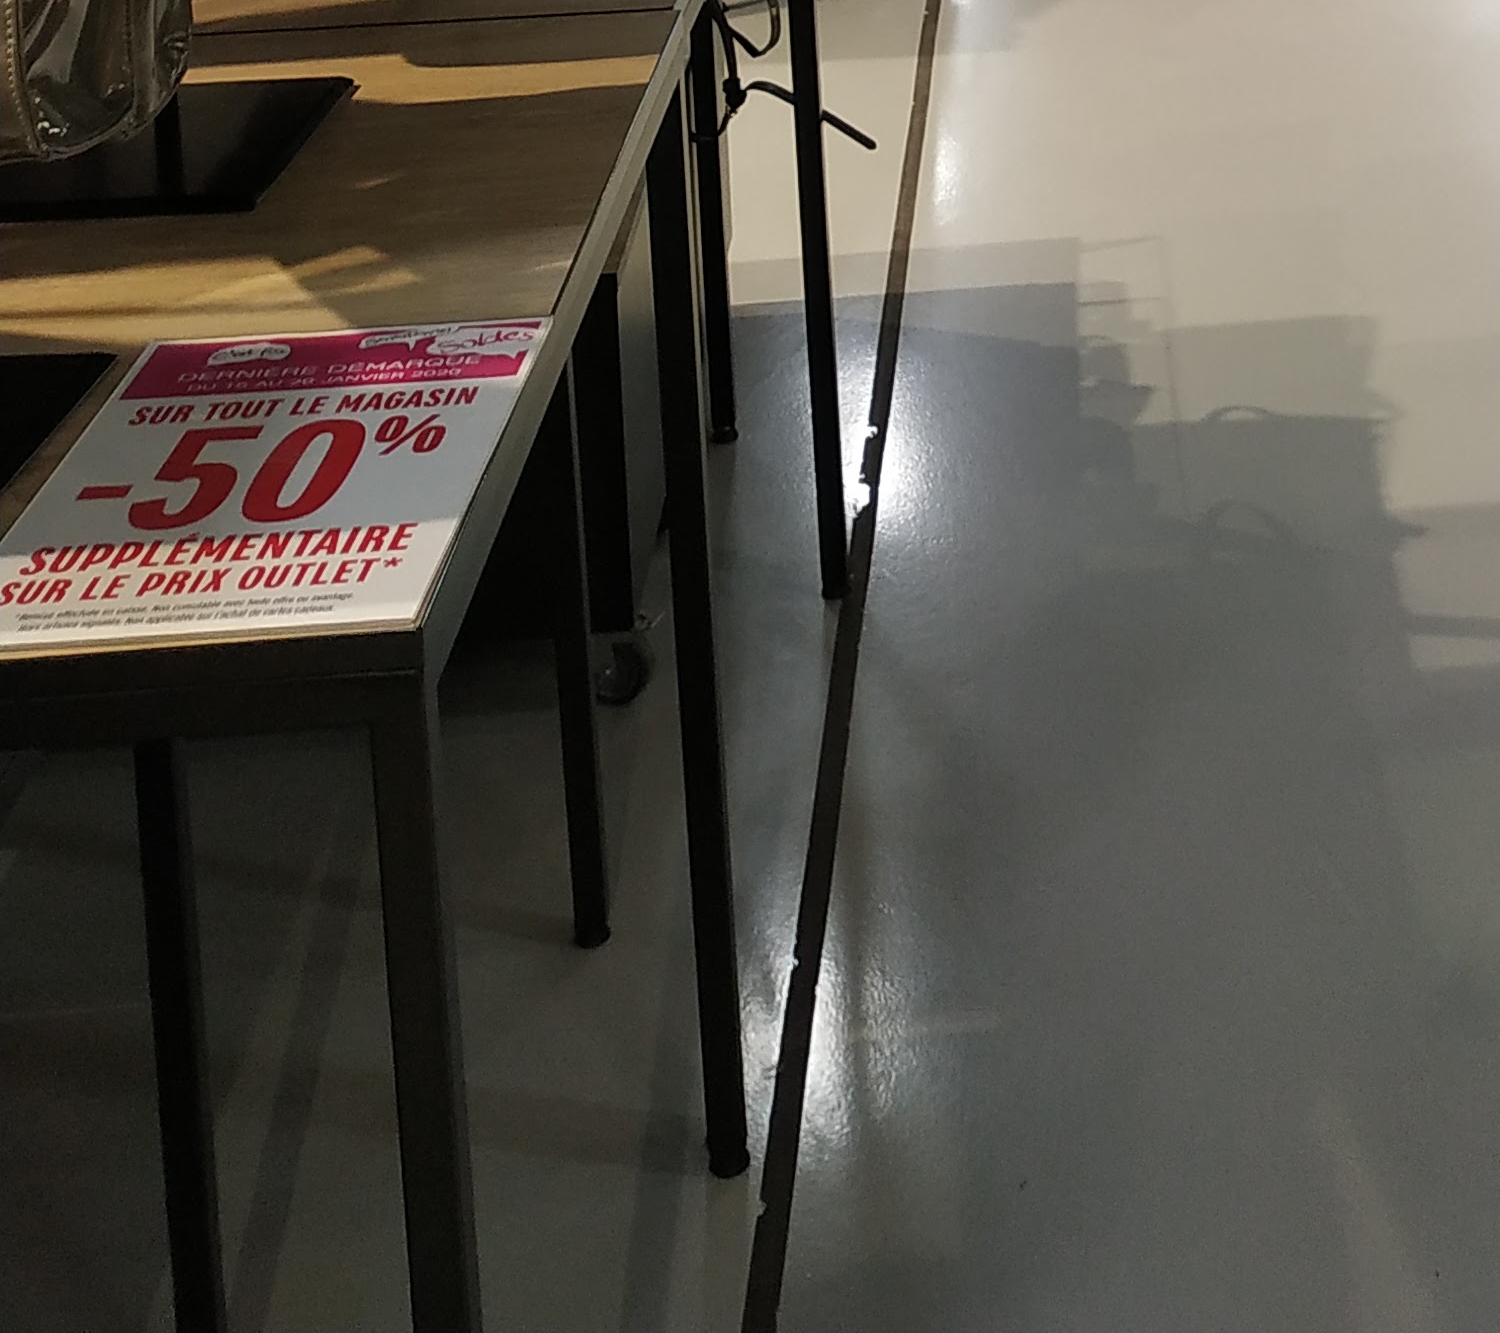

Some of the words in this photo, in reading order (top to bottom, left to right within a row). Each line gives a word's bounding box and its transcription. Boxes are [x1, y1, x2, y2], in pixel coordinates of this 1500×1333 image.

[438, 330, 534, 354] Soldes
[128, 404, 194, 426] SUR
[206, 399, 280, 422] TOUT
[288, 396, 327, 417] LE
[340, 386, 480, 413] MAGASIN
[19, 523, 418, 576] SUPPLÉMENTAIRE
[0, 577, 67, 607] SUR
[79, 575, 130, 601] LE
[136, 568, 231, 597] PRIX
